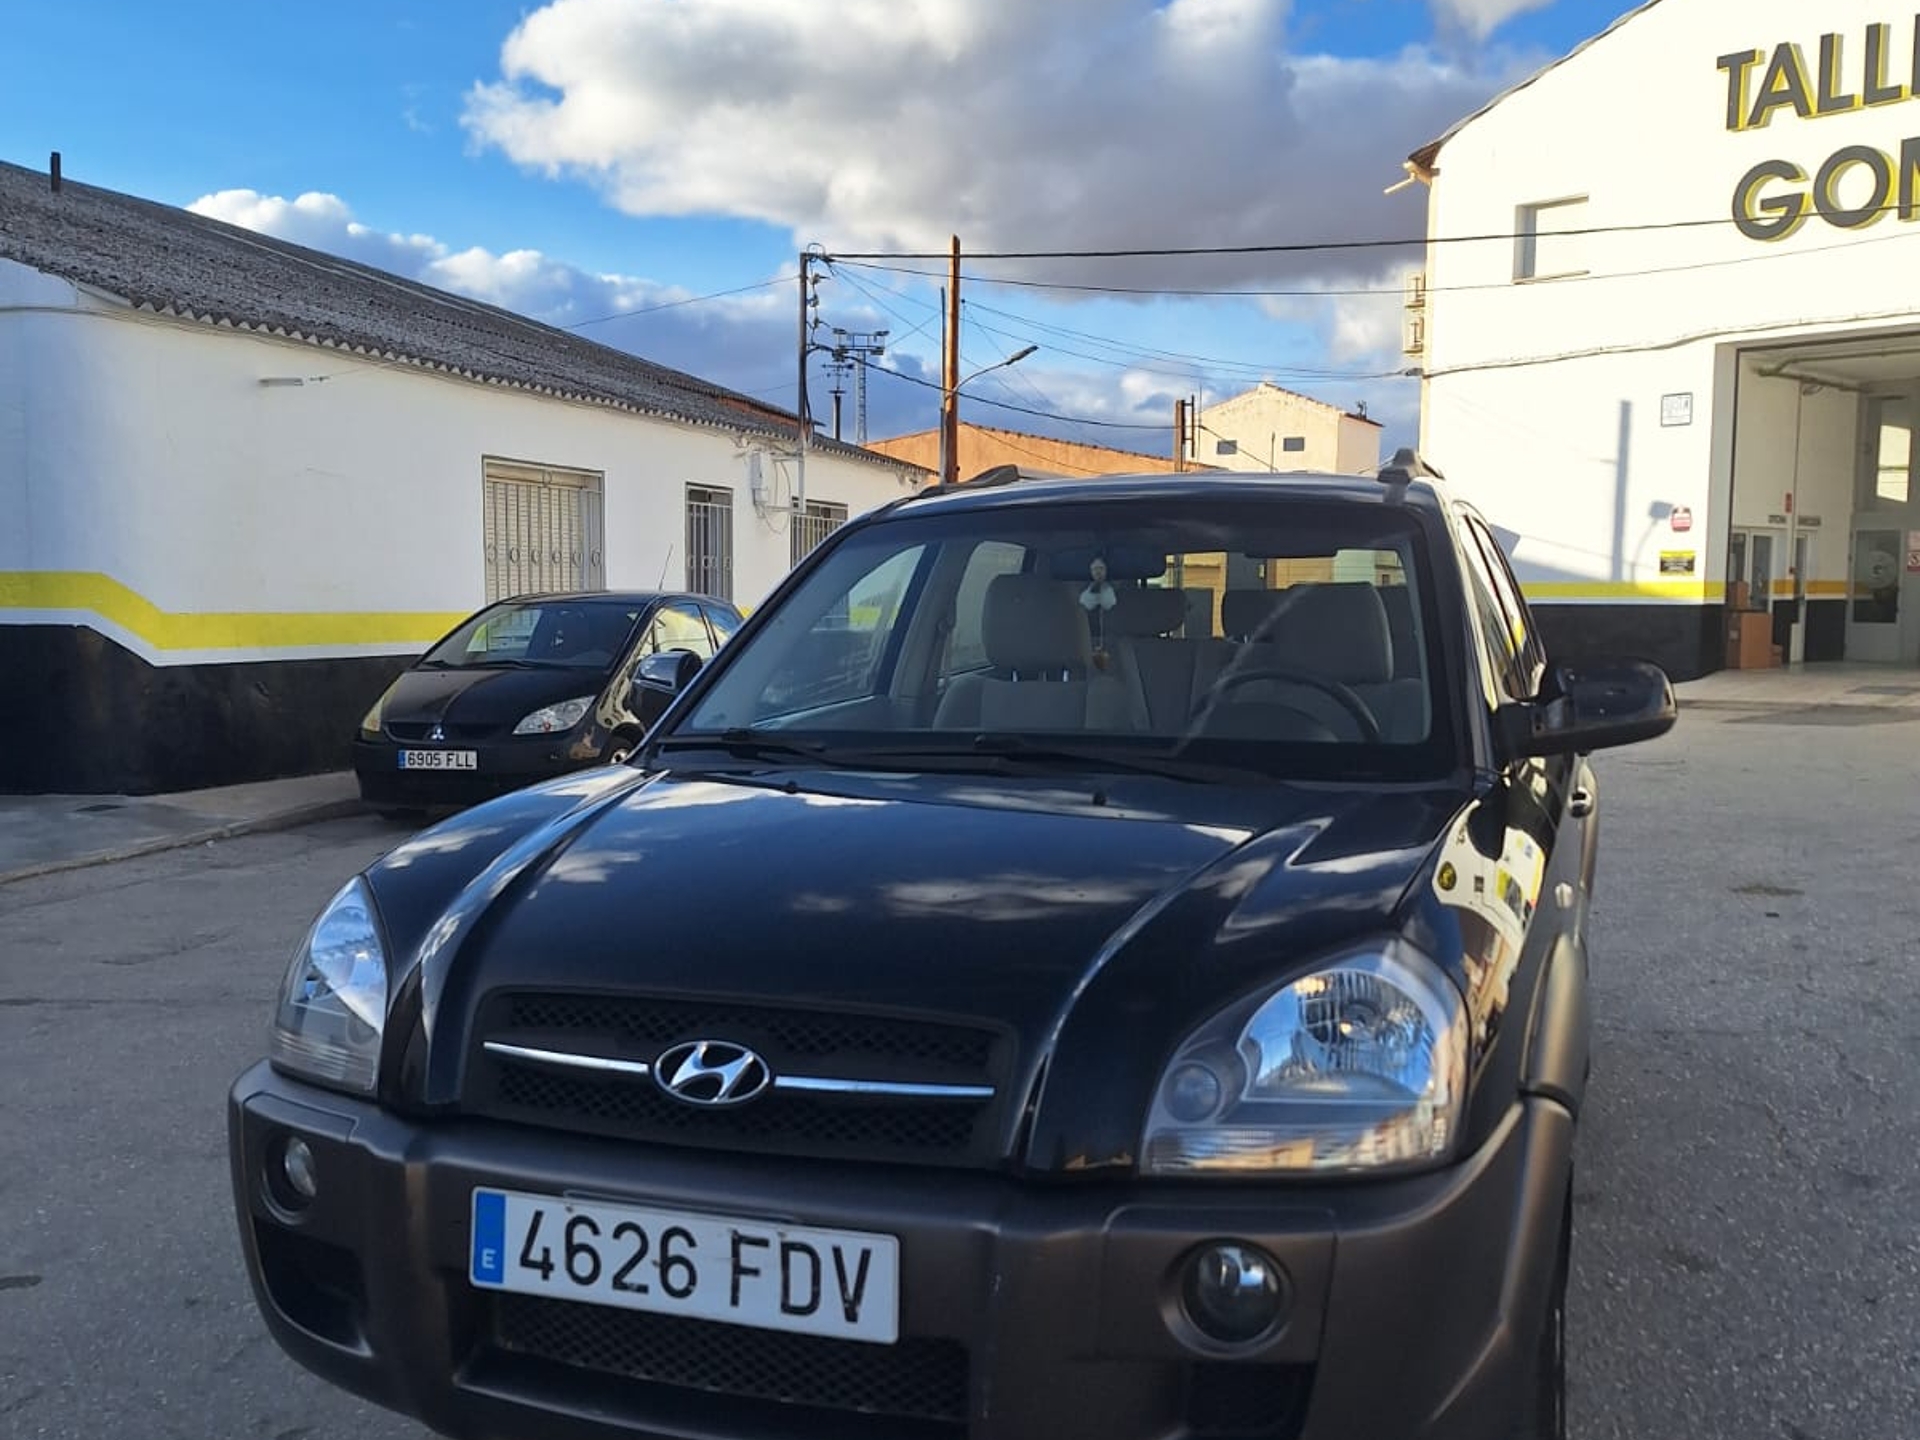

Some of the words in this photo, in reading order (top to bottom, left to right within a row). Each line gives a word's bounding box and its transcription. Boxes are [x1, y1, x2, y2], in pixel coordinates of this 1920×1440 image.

[1717, 12, 1920, 131] TALL
[408, 752, 441, 767] 6905
[446, 753, 474, 768] FLL
[481, 1248, 496, 1270] E
[519, 1209, 699, 1300] 4626
[729, 1230, 872, 1323] FDV
